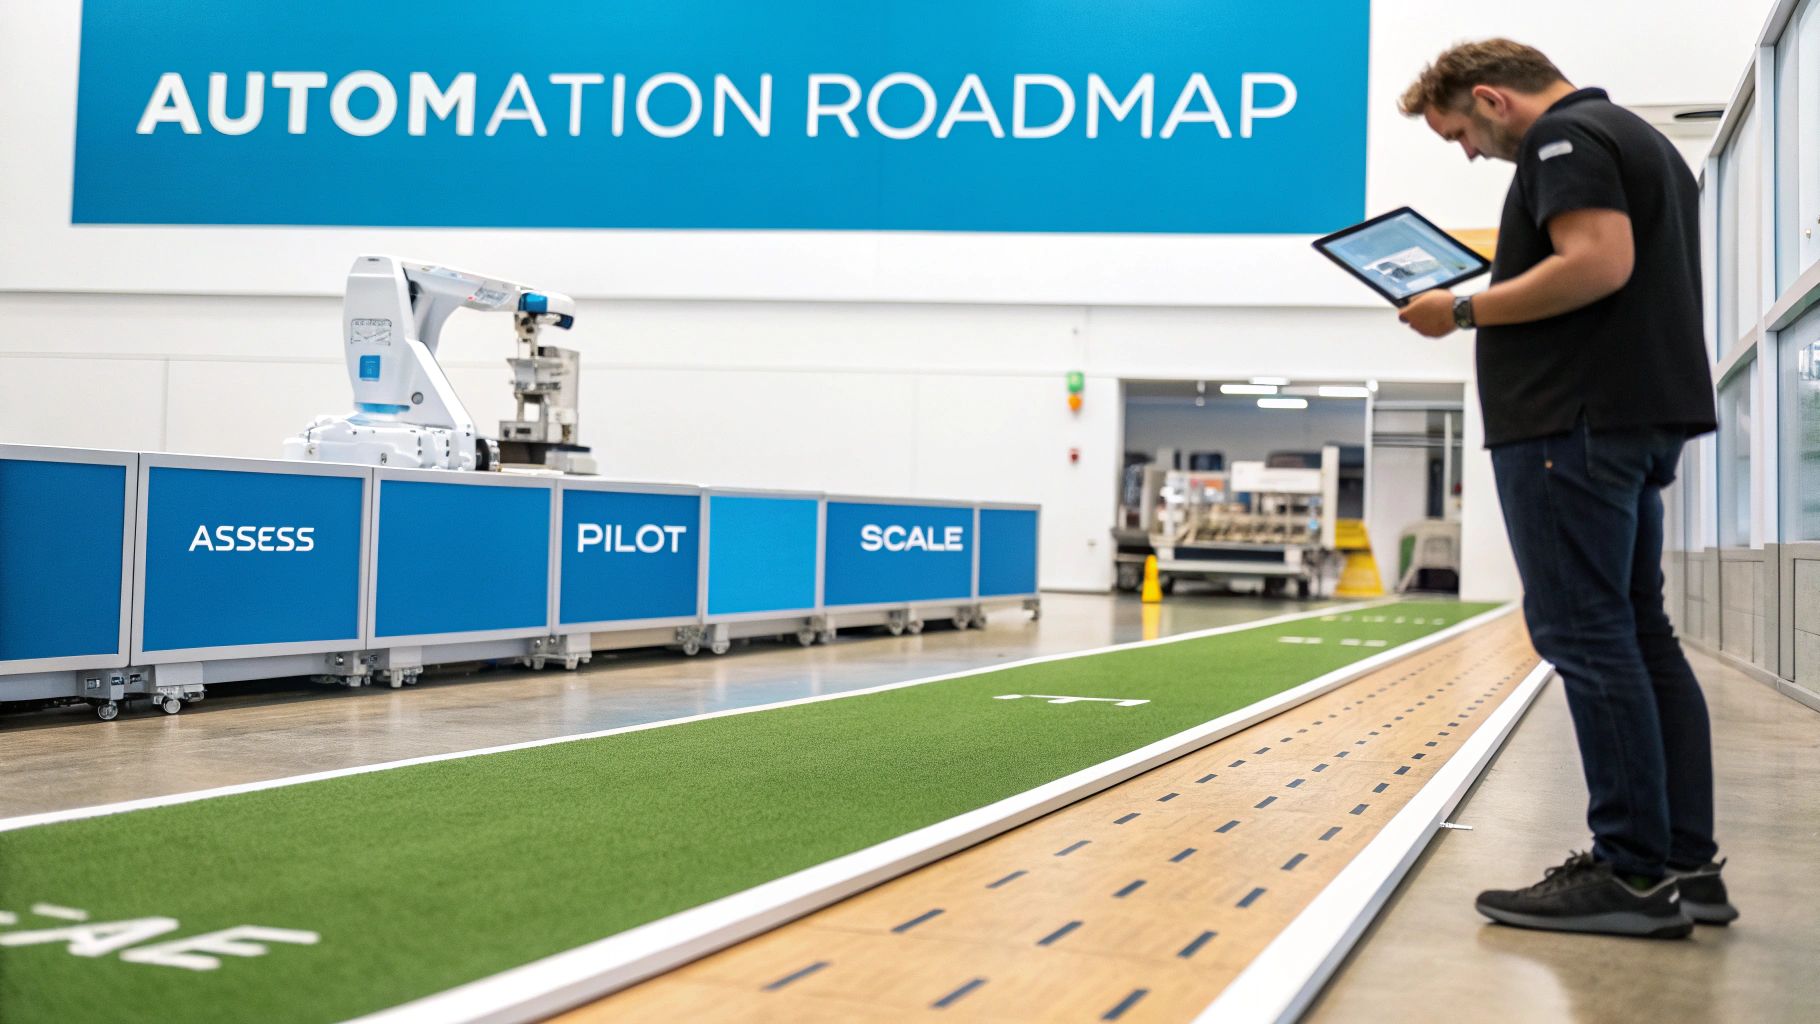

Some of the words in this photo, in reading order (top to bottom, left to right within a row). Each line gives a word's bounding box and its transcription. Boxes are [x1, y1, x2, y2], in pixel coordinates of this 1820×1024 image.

[135, 70, 774, 138] AUTOMATION
[805, 72, 1299, 140] ROADMAP
[188, 524, 316, 553] ASSESS
[576, 522, 688, 554] PILOT
[860, 524, 965, 552] SCALE
